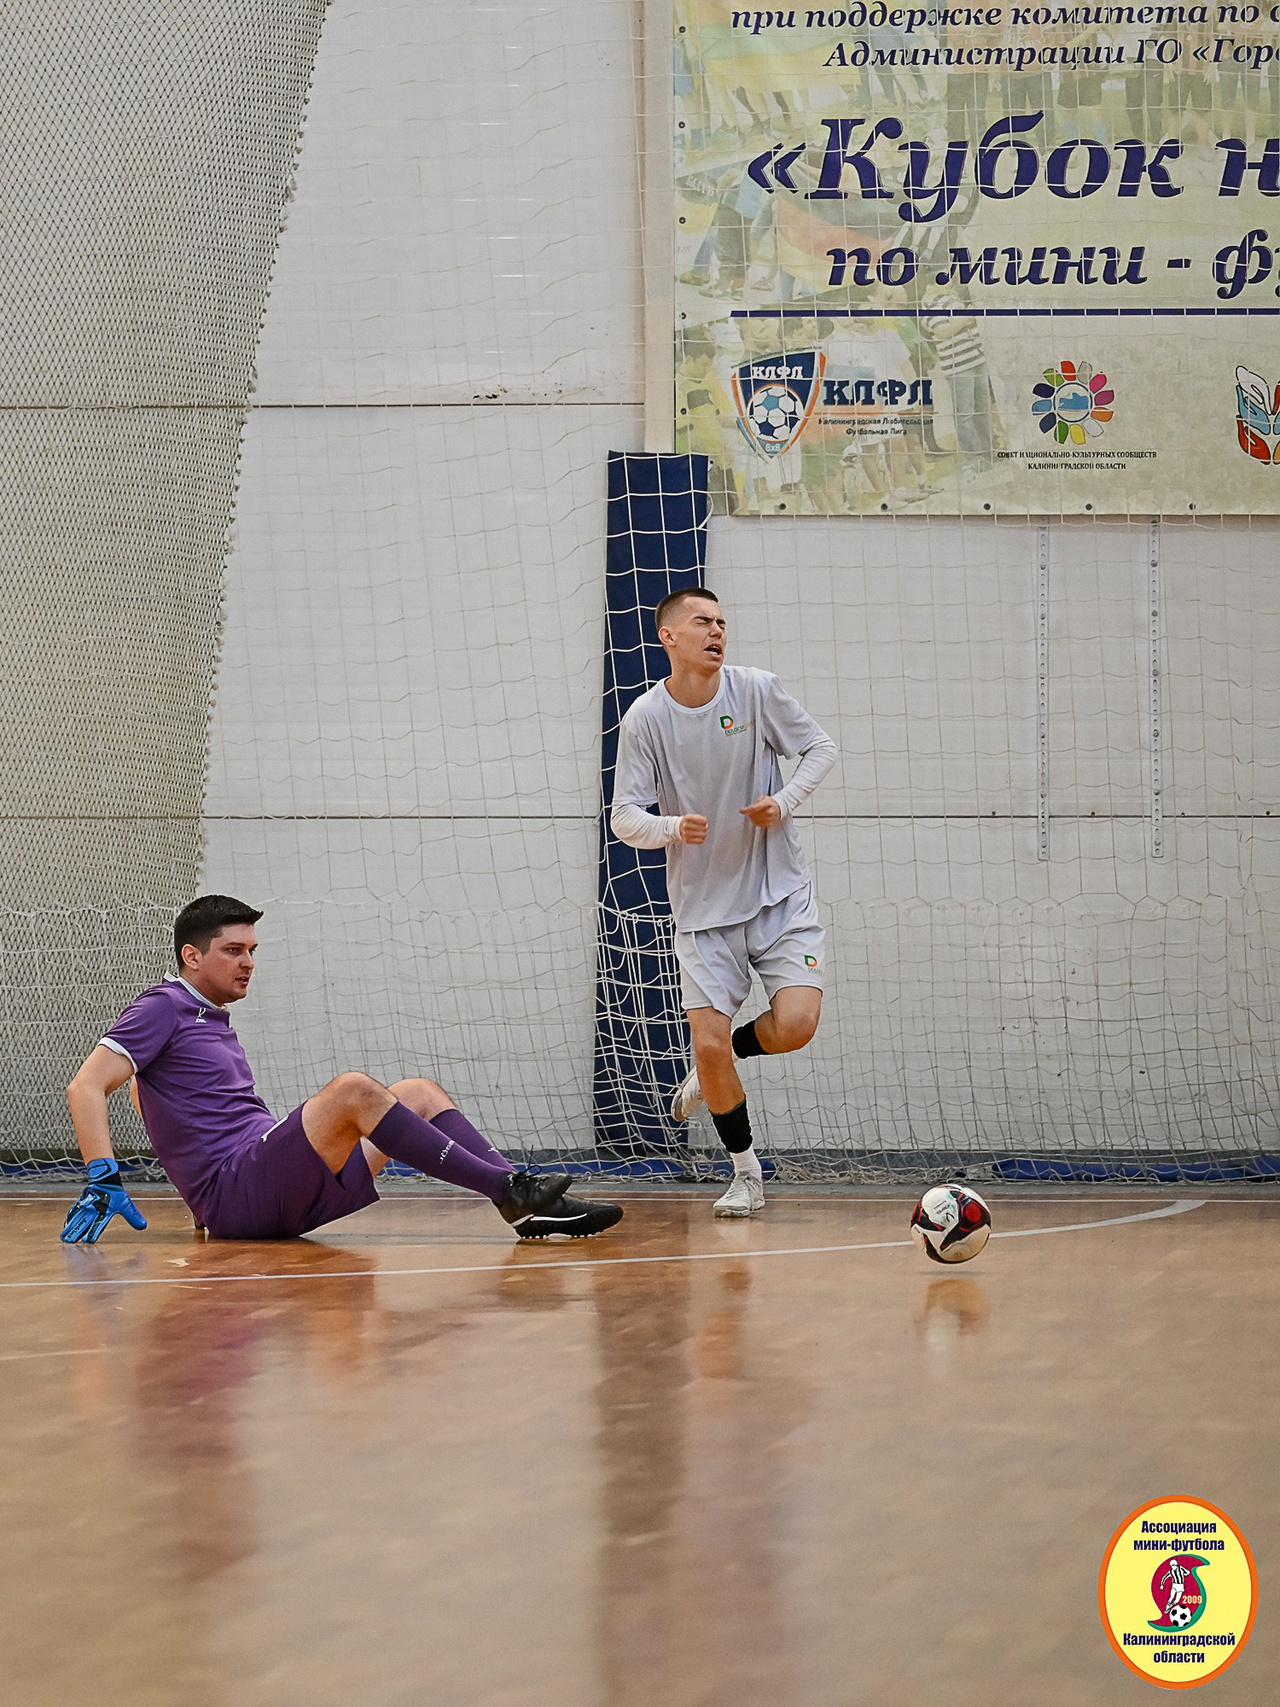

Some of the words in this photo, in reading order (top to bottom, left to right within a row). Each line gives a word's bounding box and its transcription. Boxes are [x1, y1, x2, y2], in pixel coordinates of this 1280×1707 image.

[731, 10, 796, 36] при
[805, 1, 1001, 34] поддержке
[1011, 5, 1208, 25] комитета
[1218, 5, 1260, 23] по
[822, 40, 1125, 71] Администрации
[1133, 38, 1182, 64] ГО
[1192, 38, 1280, 70] «Гор
[747, 110, 1185, 223] «Кубок
[826, 246, 920, 287] по
[935, 246, 1148, 286] мини
[1212, 229, 1280, 299] ф
[752, 366, 803, 379] КЛФЛ
[823, 378, 933, 406] КЛФЛ
[1095, 462, 1127, 470] ОБЛАСТИ
[1116, 451, 1158, 460] СООБЩЕСТВ
